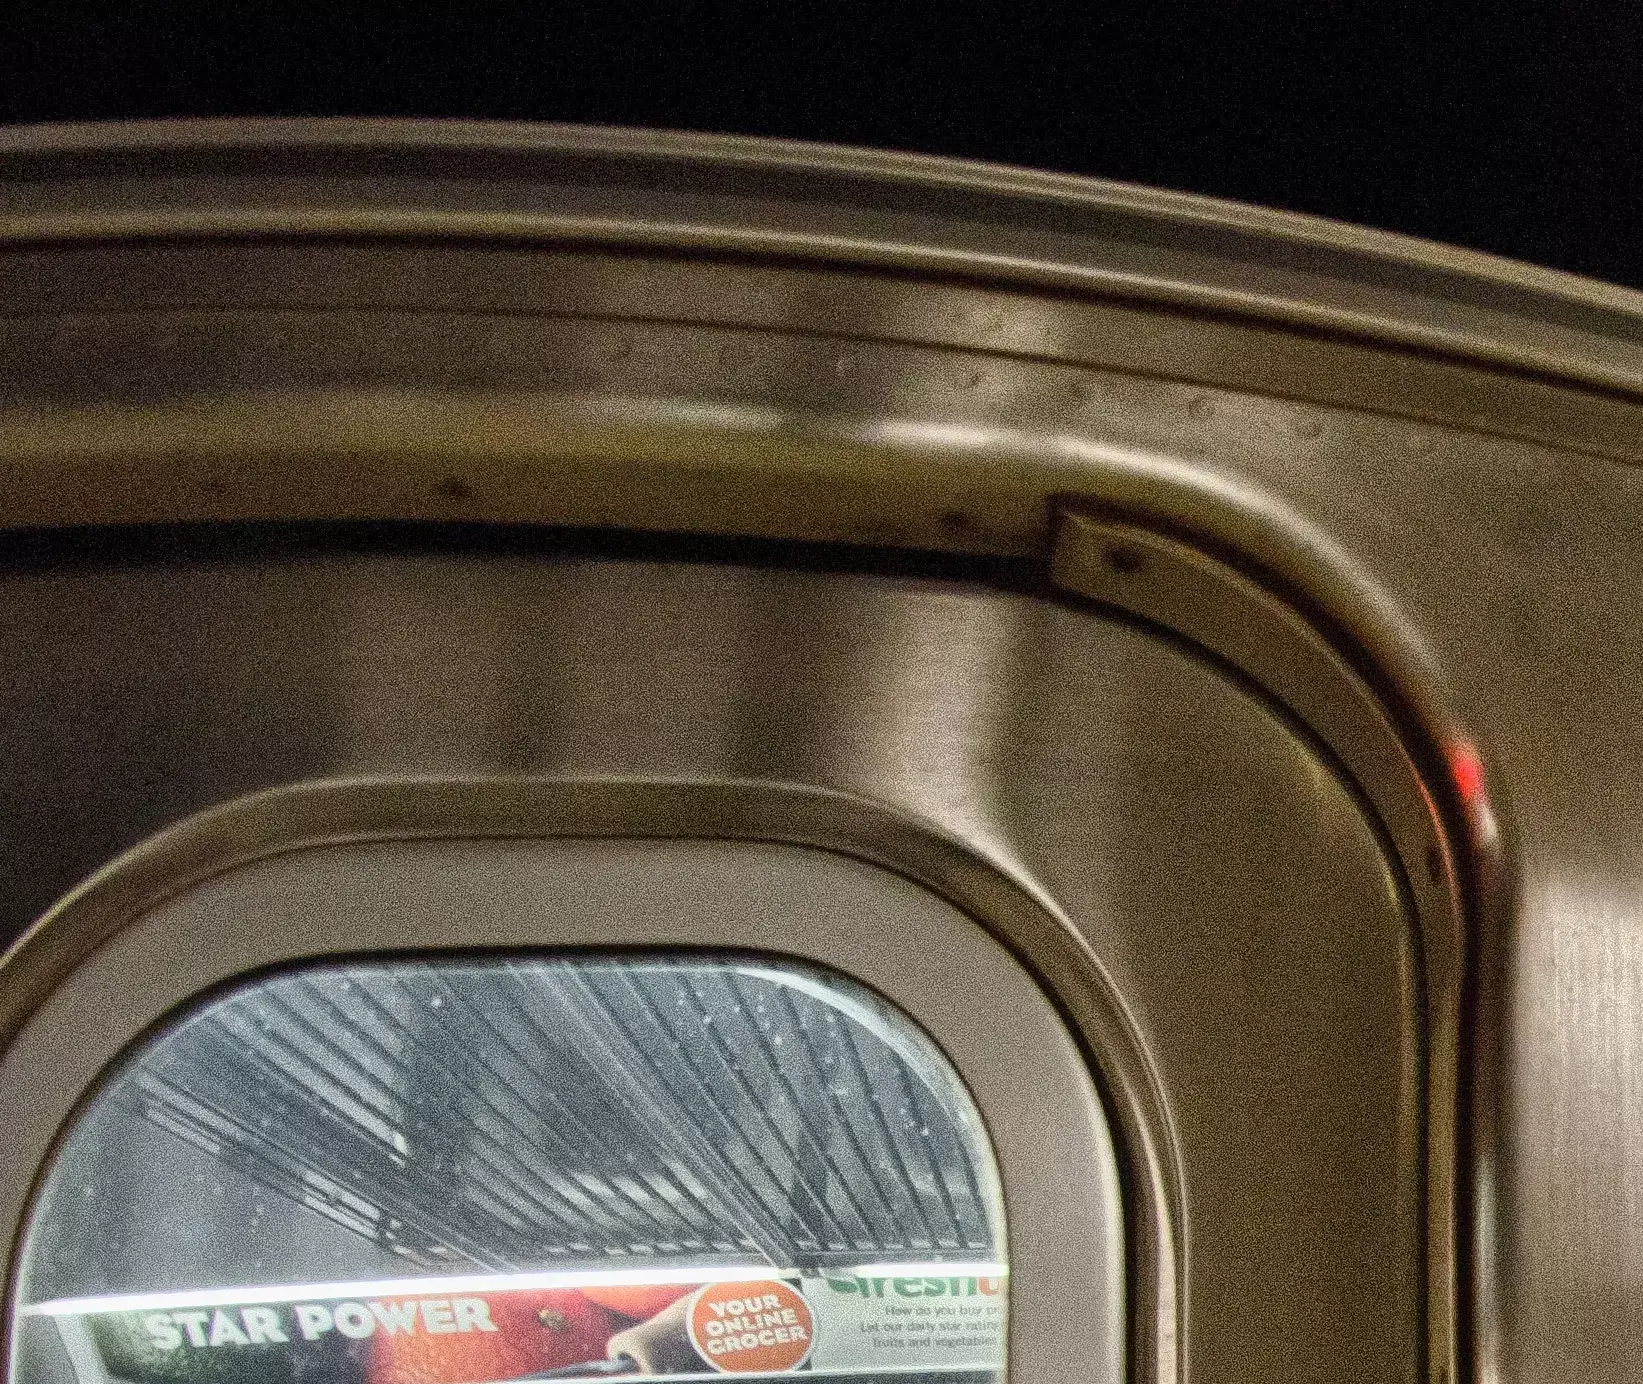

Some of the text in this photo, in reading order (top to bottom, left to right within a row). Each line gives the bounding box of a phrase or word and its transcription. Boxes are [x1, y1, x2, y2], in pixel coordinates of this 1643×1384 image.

[708, 1295, 781, 1318] YOUR
[144, 1298, 499, 1350] STAR POWER
[705, 1308, 797, 1337] ONLINE
[707, 1325, 808, 1355] GROCER
